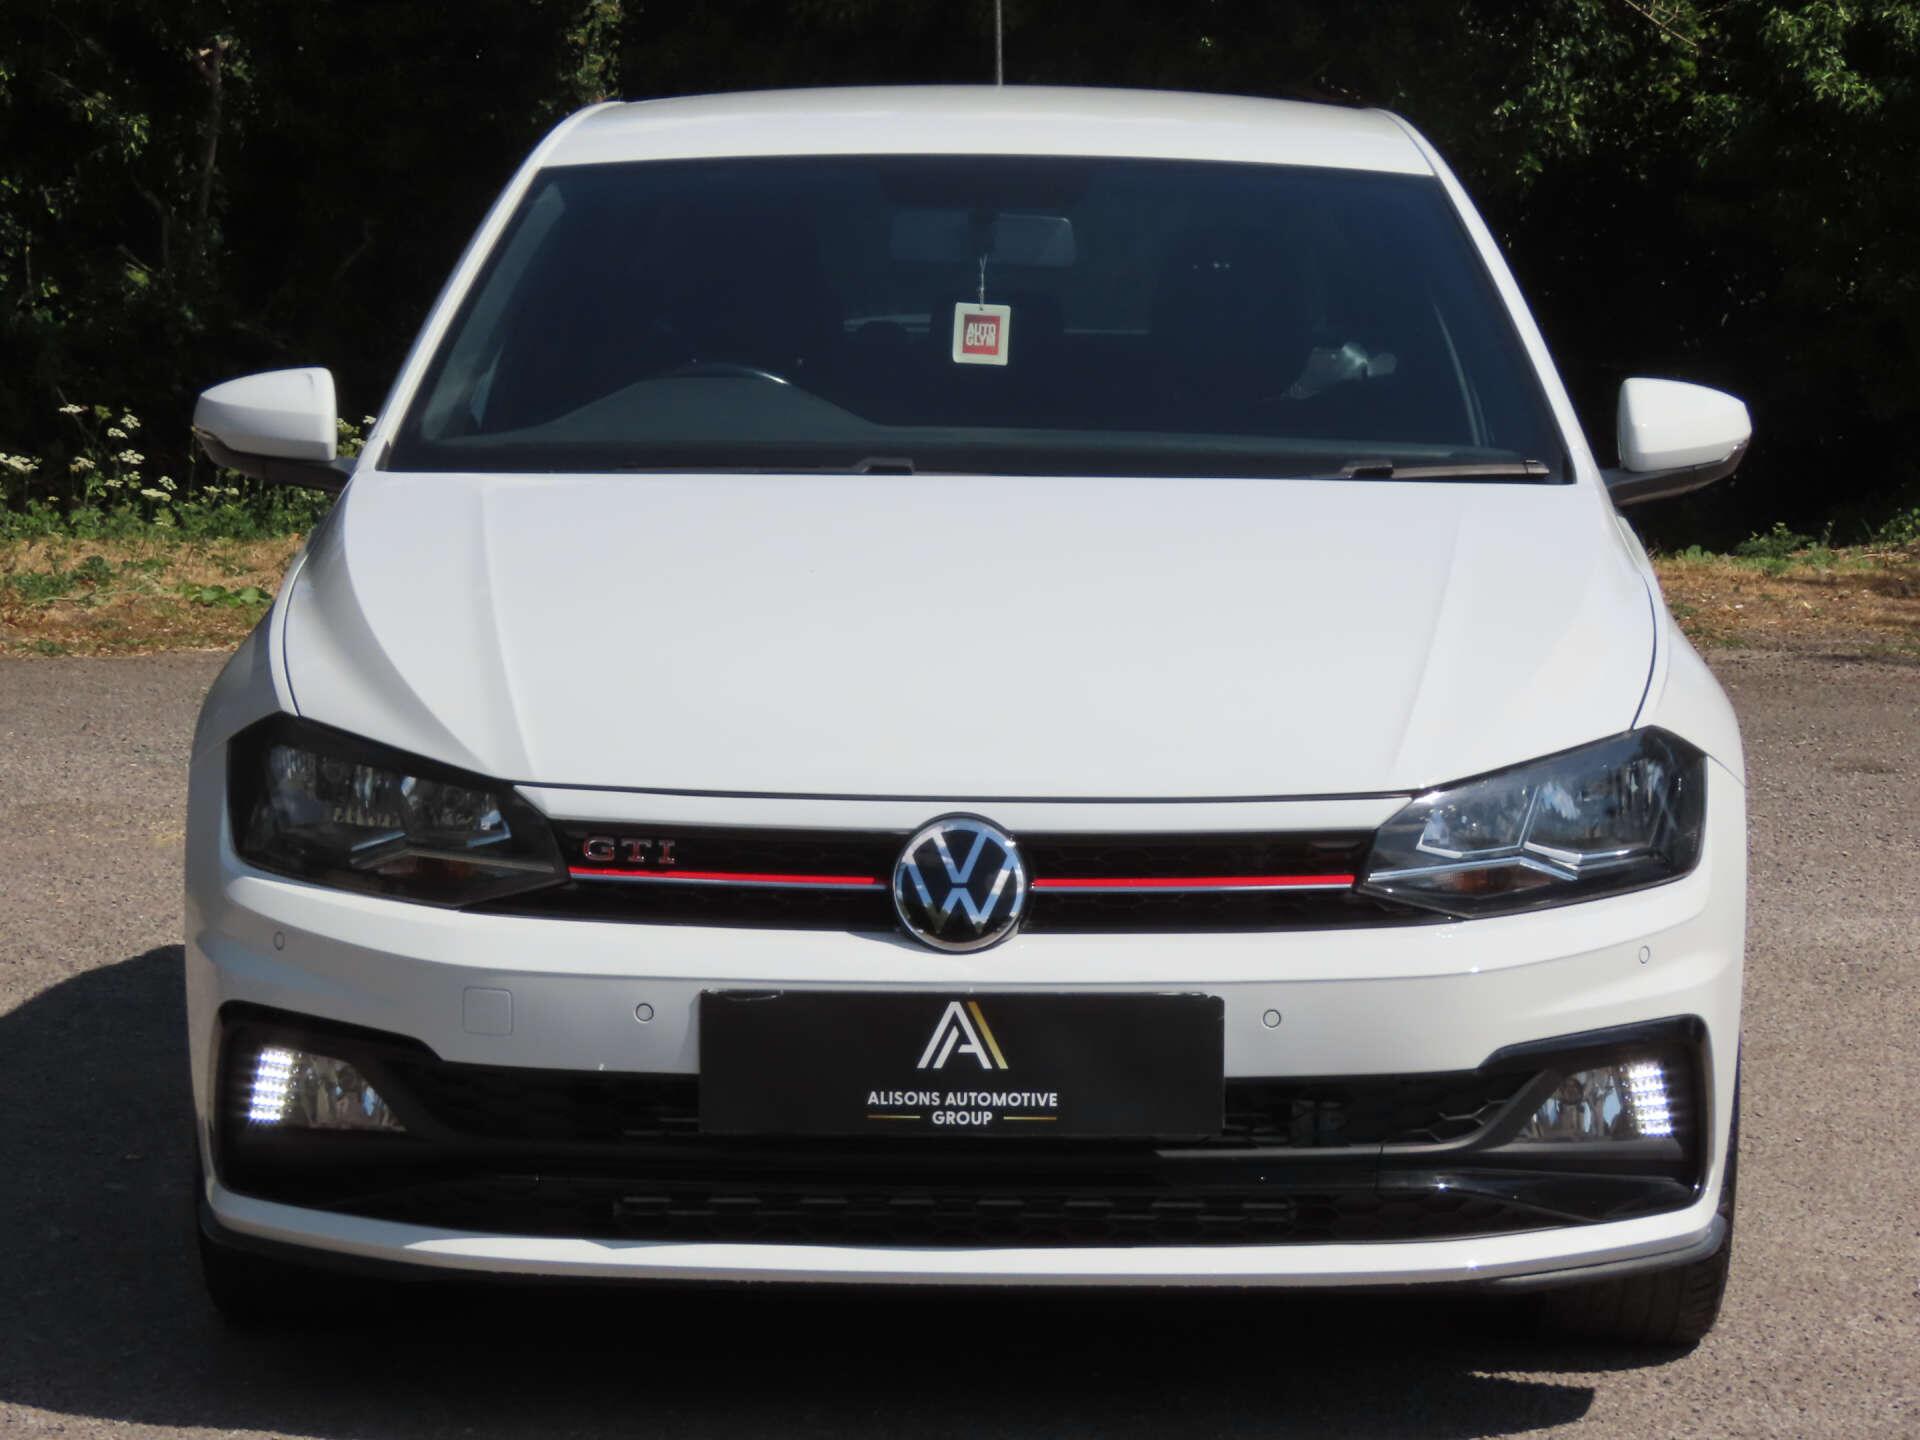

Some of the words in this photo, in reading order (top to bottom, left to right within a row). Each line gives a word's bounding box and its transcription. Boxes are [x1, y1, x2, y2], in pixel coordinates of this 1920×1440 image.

[967, 322, 996, 336] AUTO
[584, 837, 675, 864] GTI
[867, 1091, 941, 1106] ALISONS
[945, 1092, 1058, 1107] AUTOMOTIVE
[932, 1111, 993, 1125] GROUP
